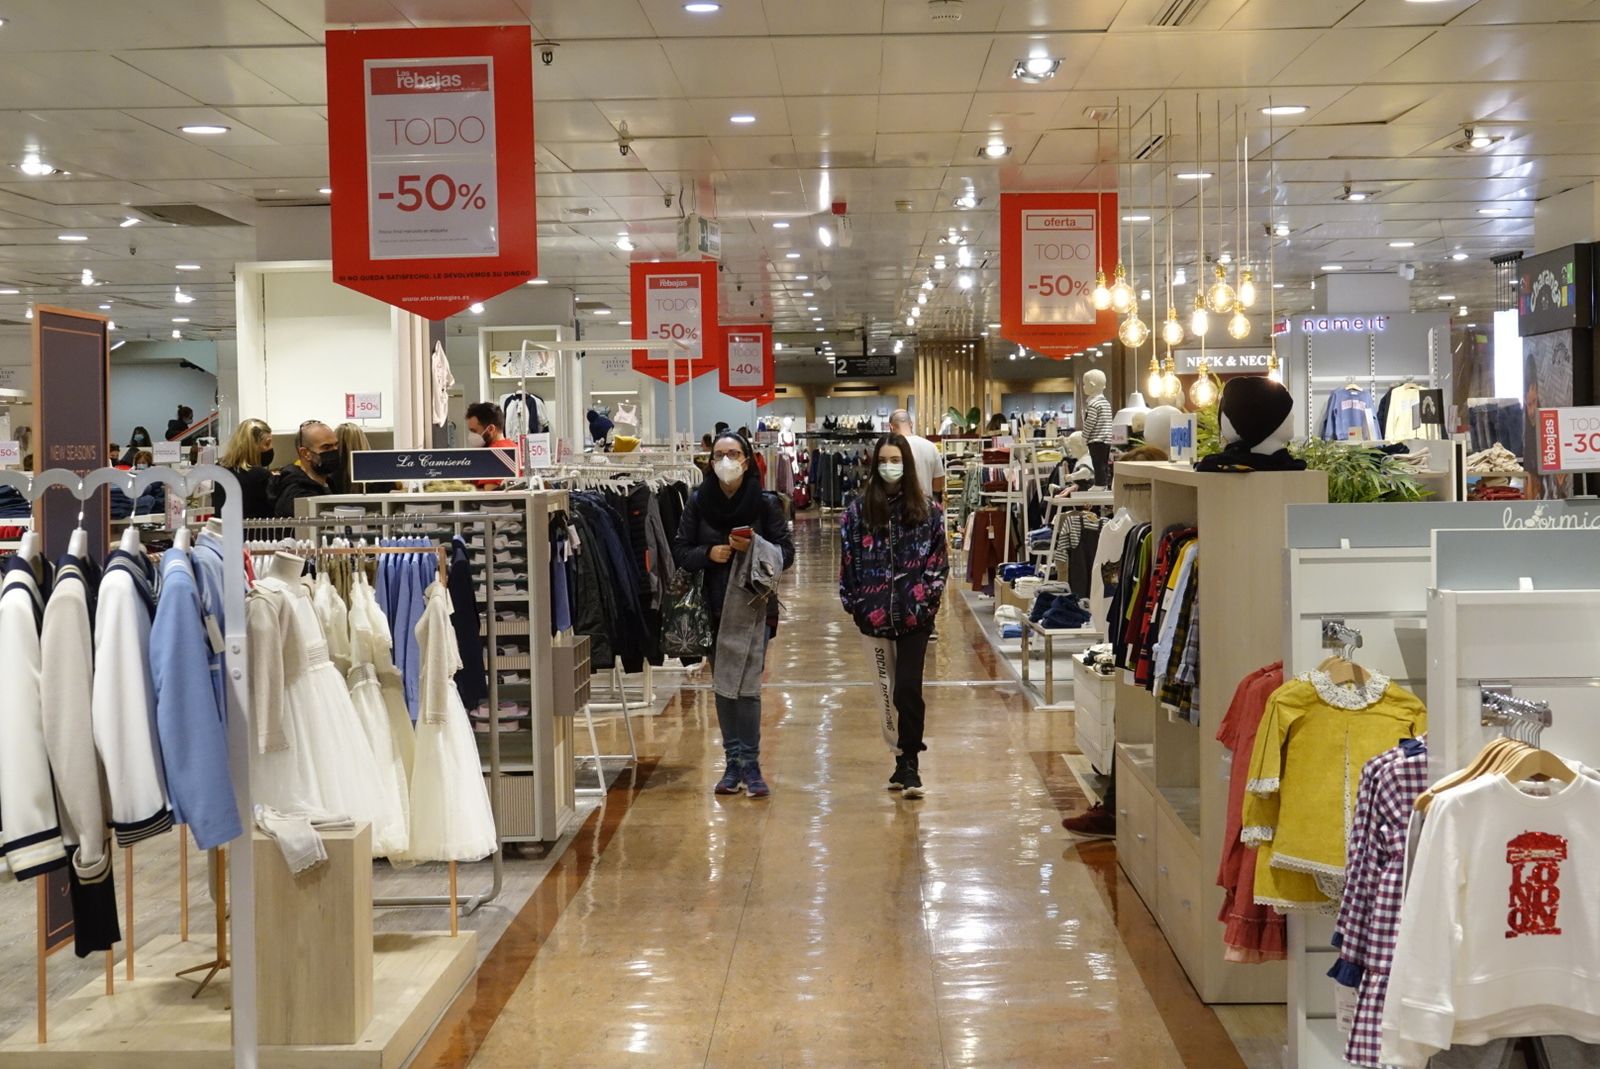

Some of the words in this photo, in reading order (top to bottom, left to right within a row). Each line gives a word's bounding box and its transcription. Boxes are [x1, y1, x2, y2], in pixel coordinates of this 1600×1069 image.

[397, 72, 462, 90] rebajas
[385, 116, 485, 145] TODO
[378, 174, 486, 212] -50%
[1044, 217, 1077, 227] oferta
[1033, 243, 1091, 261] TODO
[659, 278, 689, 288] rebajas
[1028, 274, 1091, 297] -50%
[655, 297, 698, 312] TODO
[651, 322, 698, 340] -50%
[837, 358, 848, 374] 2
[1225, 355, 1238, 367] &
[1568, 416, 1600, 431] TOD
[1544, 418, 1558, 465] rebajas
[396, 454, 414, 468] La
